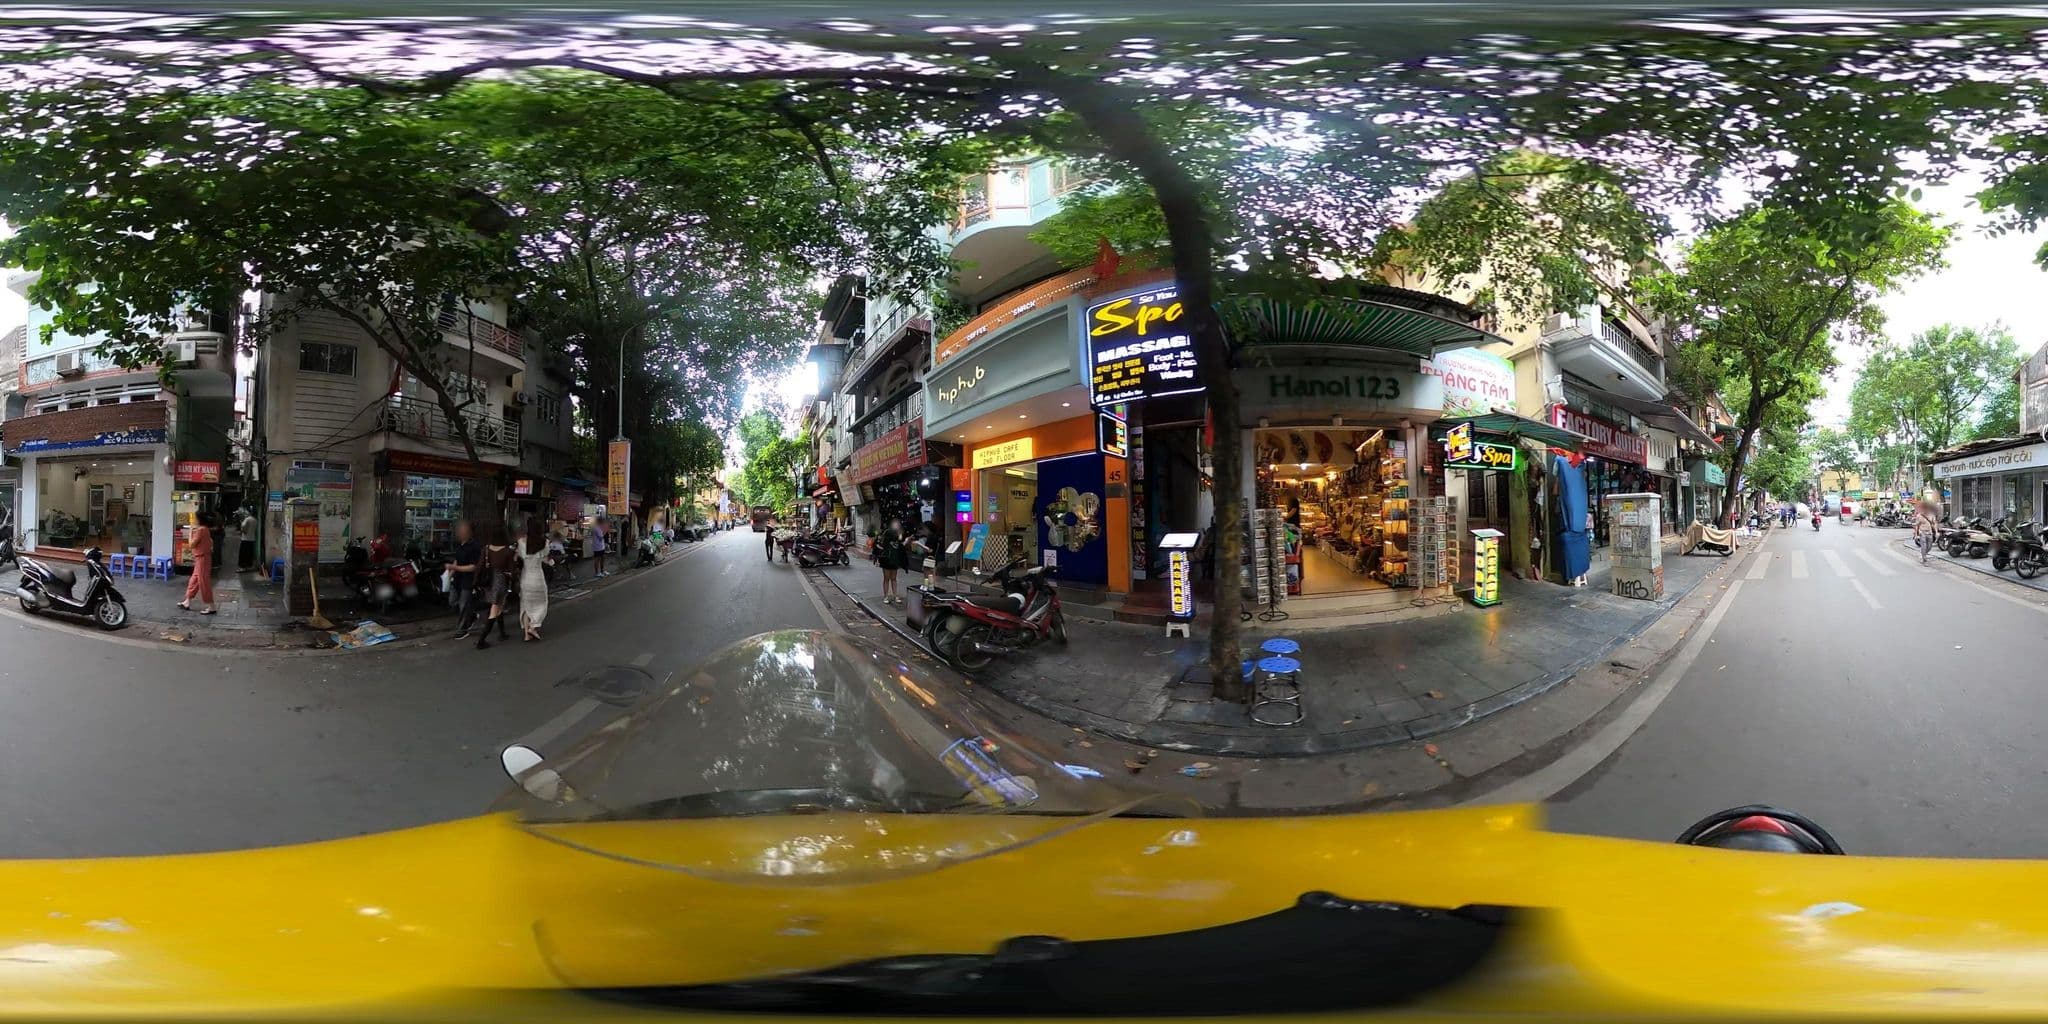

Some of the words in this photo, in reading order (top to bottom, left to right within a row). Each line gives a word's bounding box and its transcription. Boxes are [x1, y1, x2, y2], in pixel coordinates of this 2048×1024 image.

[1012, 299, 1036, 316] SNACK
[1090, 298, 1184, 336] Spa
[1097, 334, 1191, 363] MASSAG
[938, 365, 985, 405] hiphub
[1357, 375, 1401, 400] 123
[1480, 379, 1510, 401] TÁM
[1556, 408, 1612, 446] FACTORY
[1614, 429, 1646, 458] OUTLET
[1482, 447, 1512, 467] Spa
[1109, 470, 1121, 481] 45
[1171, 553, 1184, 612] MASSAGE
